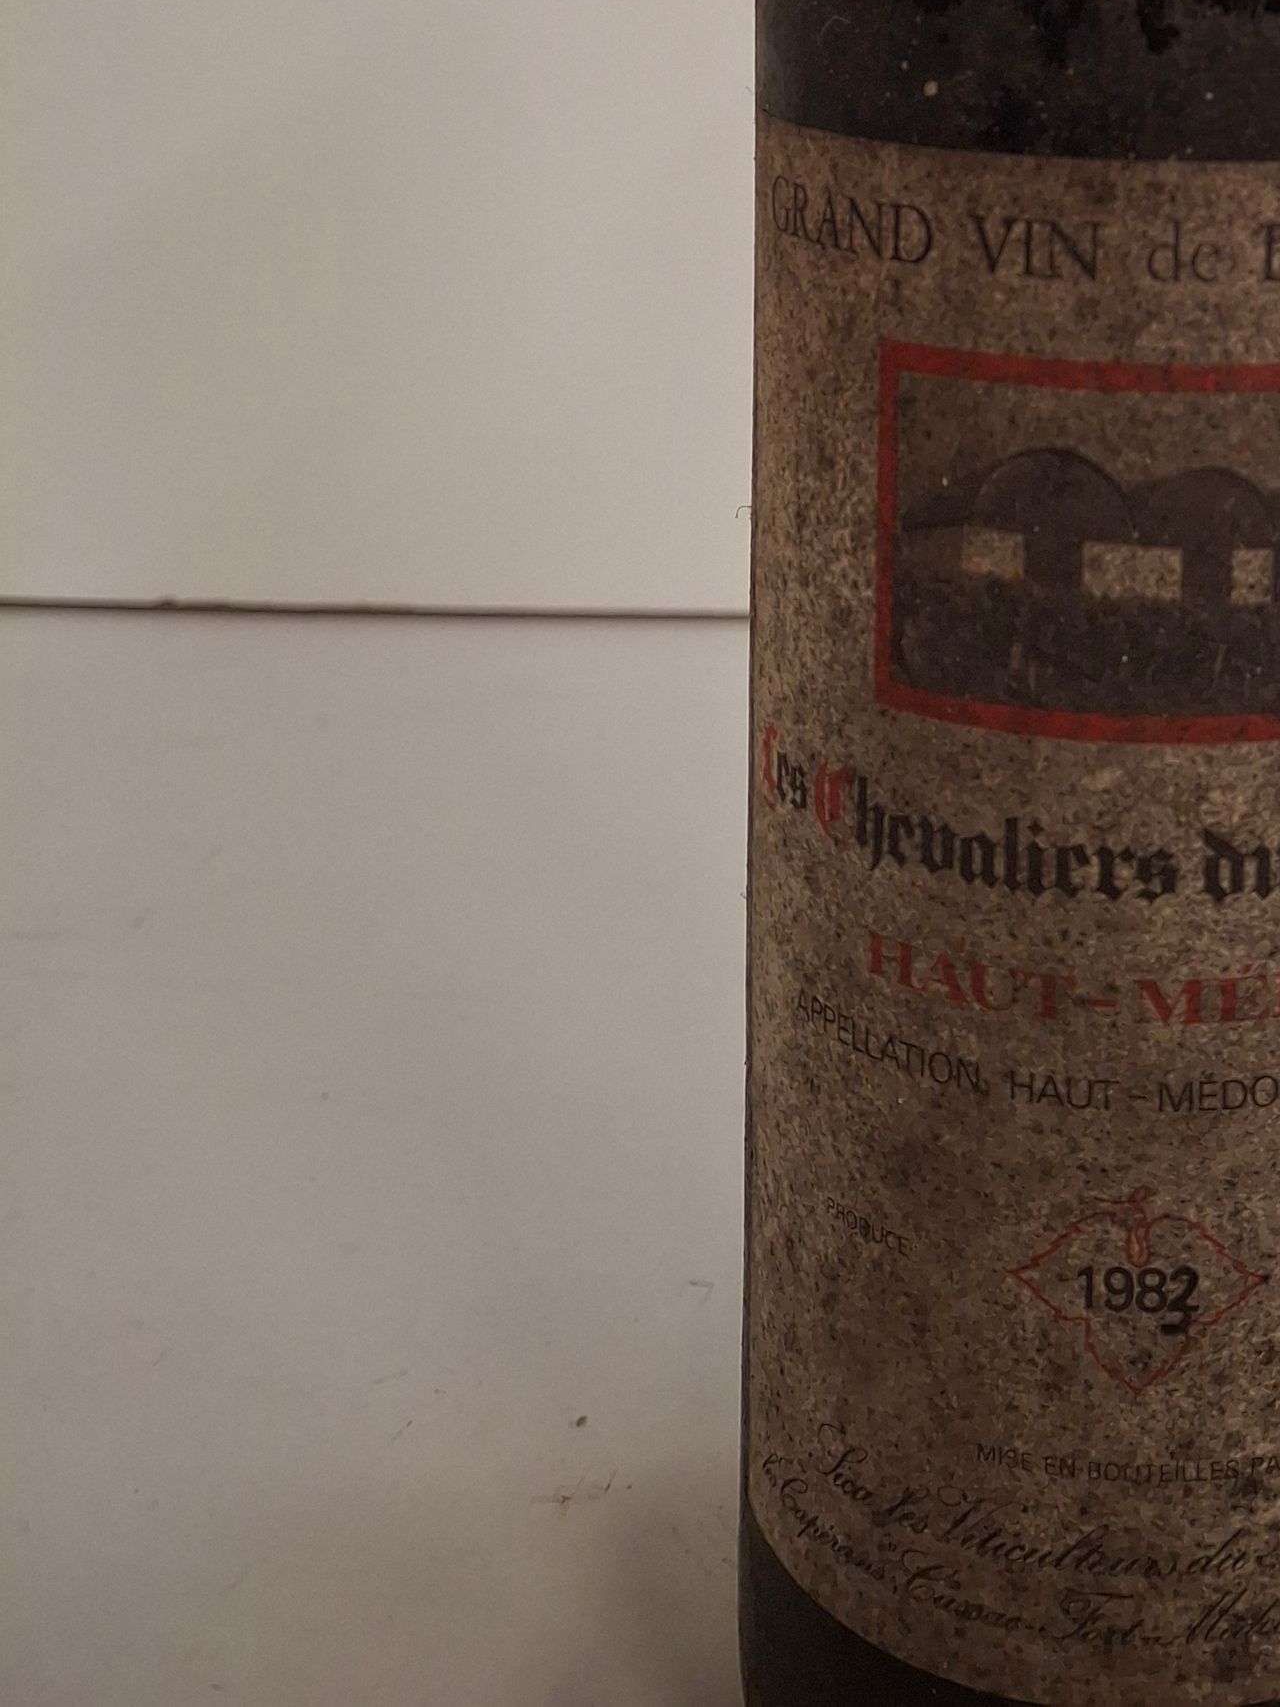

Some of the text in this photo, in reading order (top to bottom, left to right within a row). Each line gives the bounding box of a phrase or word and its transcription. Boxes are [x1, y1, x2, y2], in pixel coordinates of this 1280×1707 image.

[772, 175, 933, 264] GRAND
[969, 214, 1100, 282] VIN
[1148, 220, 1221, 283] de
[762, 723, 808, 812] Les
[814, 757, 1180, 904] Chevaliers
[796, 987, 981, 1093] APPELLATION
[825, 1195, 910, 1259] PRODUCE
[1076, 1263, 1201, 1318] 1982
[974, 1443, 1033, 1473] MISE
[1044, 1455, 1077, 1477] EN
[1087, 1459, 1239, 1483] BOUTEILLES
[1187, 1528, 1251, 1575] du
